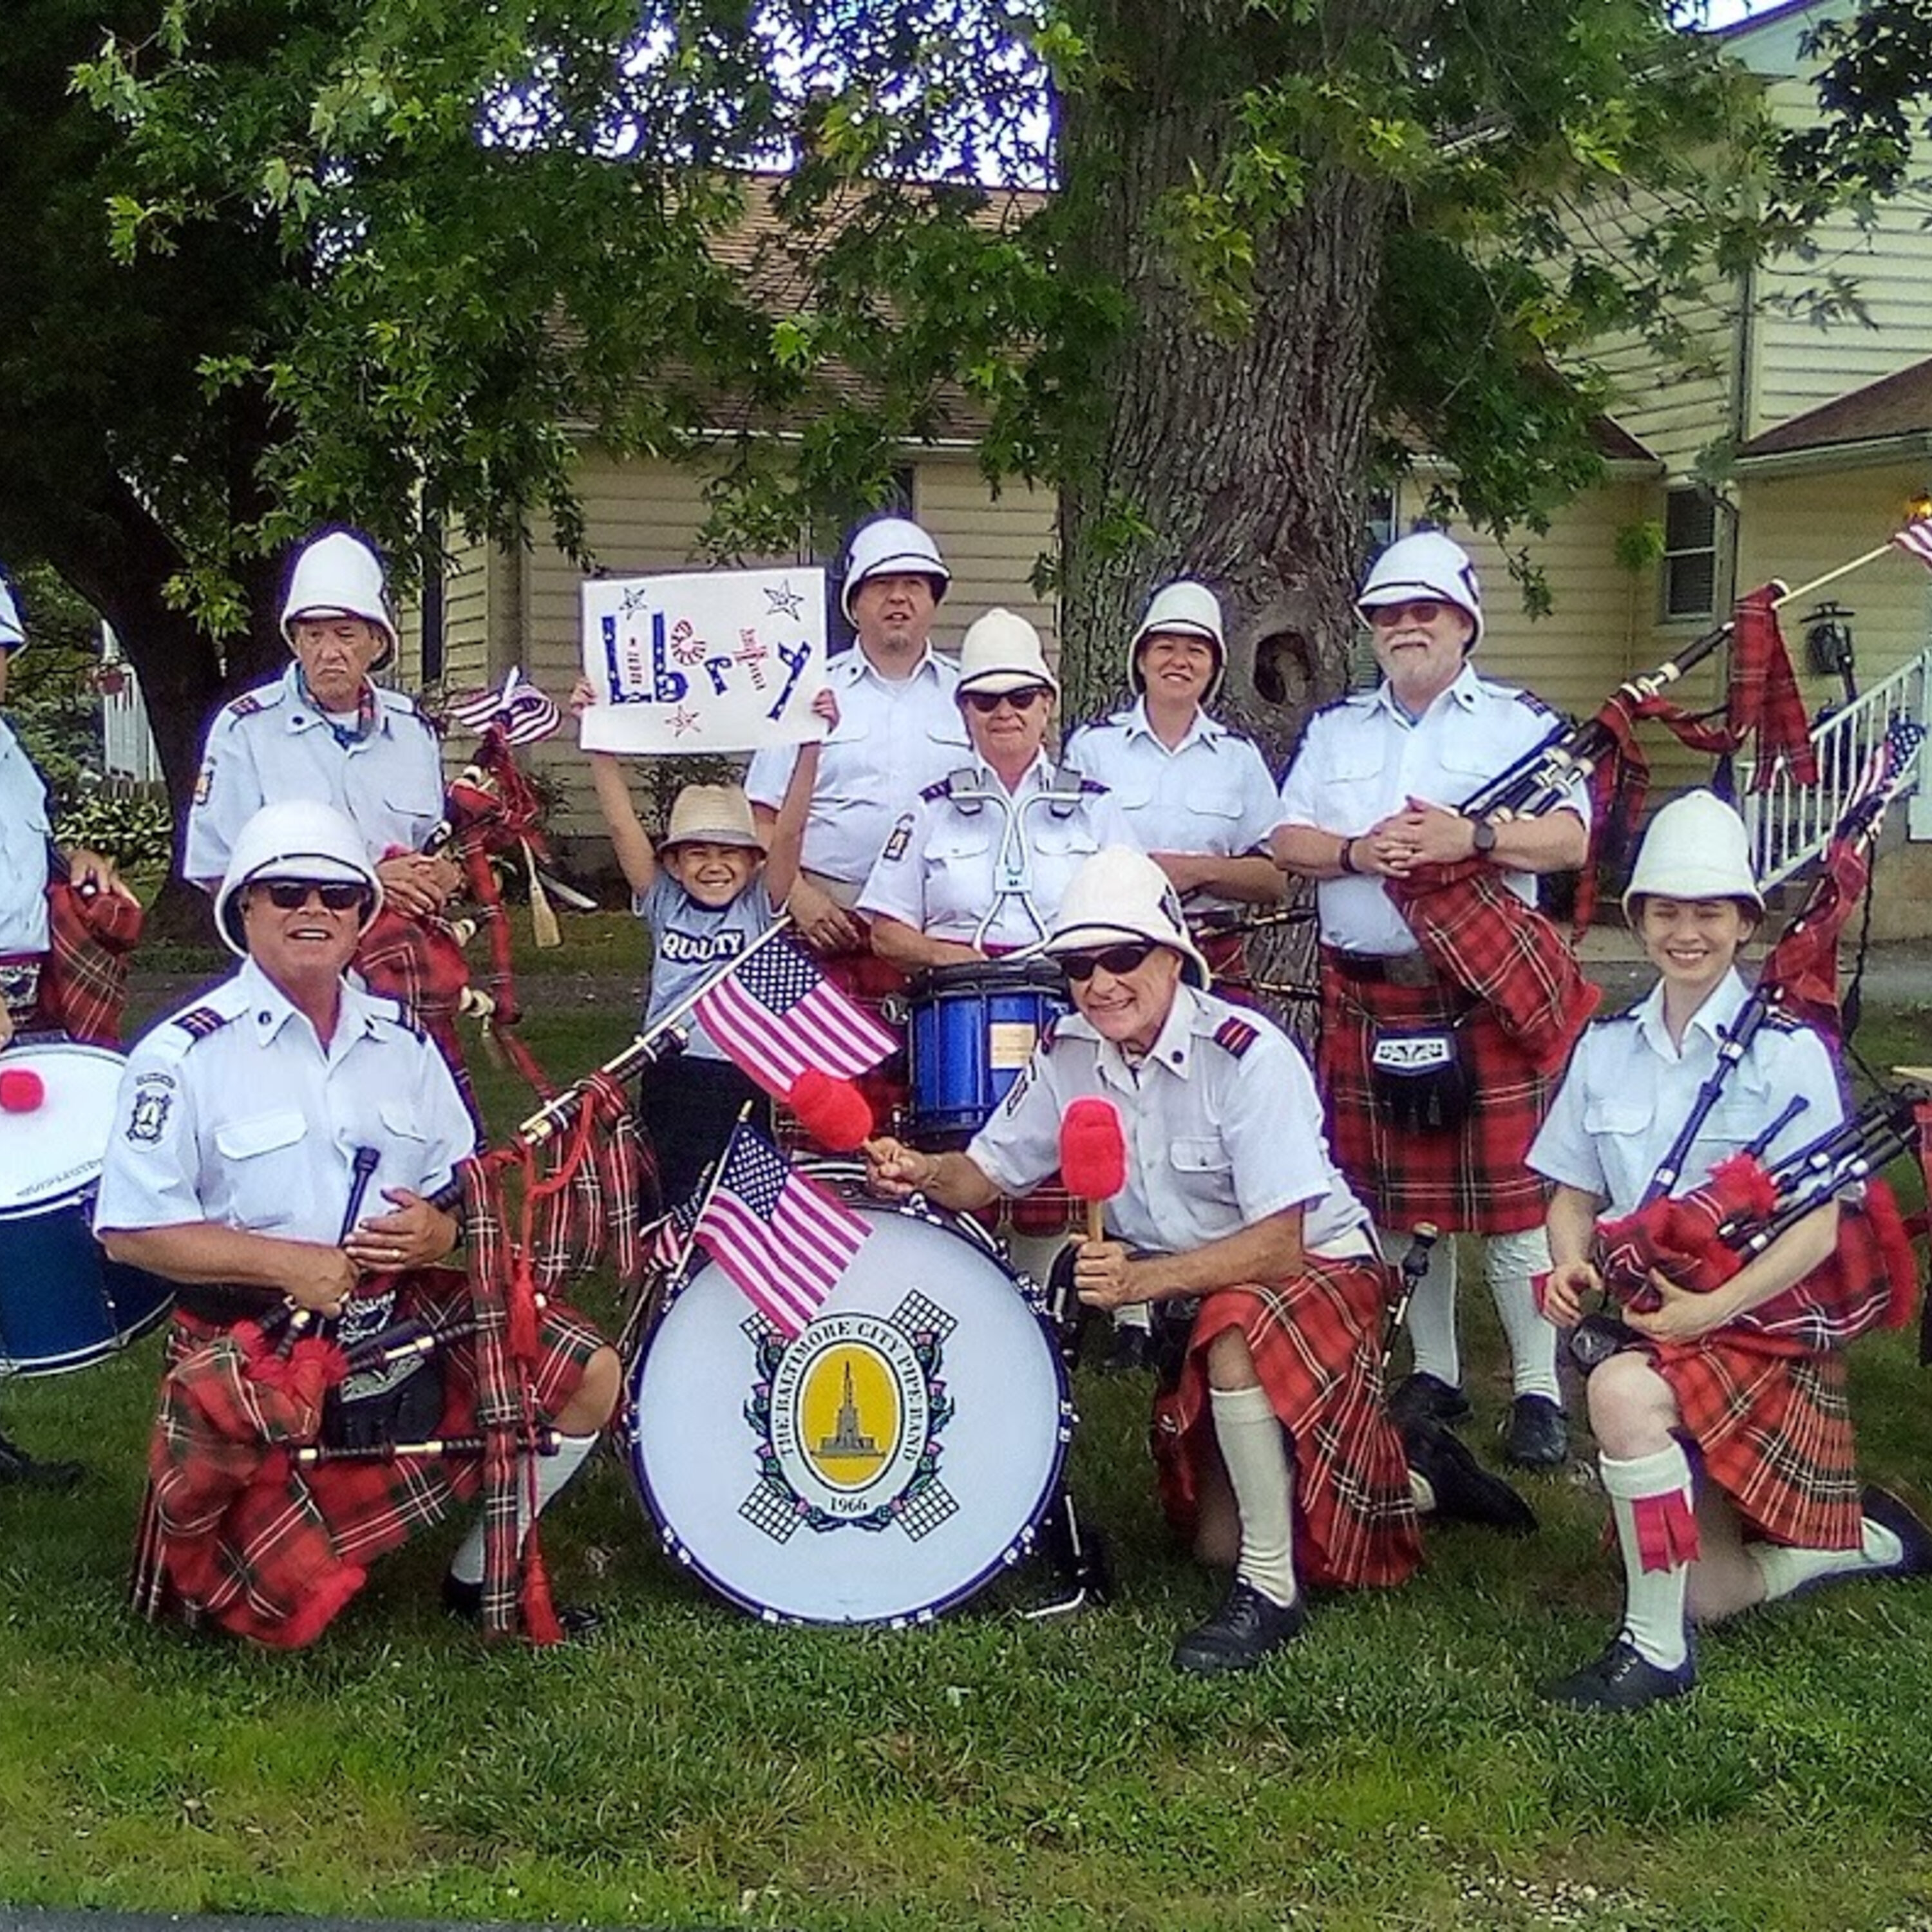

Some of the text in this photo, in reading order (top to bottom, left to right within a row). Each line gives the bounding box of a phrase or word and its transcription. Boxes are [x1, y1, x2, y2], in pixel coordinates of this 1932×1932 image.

[775, 1321, 923, 1461] THE BALTIMORE CITY PIPE BAND
[830, 1495, 867, 1513] 1966
